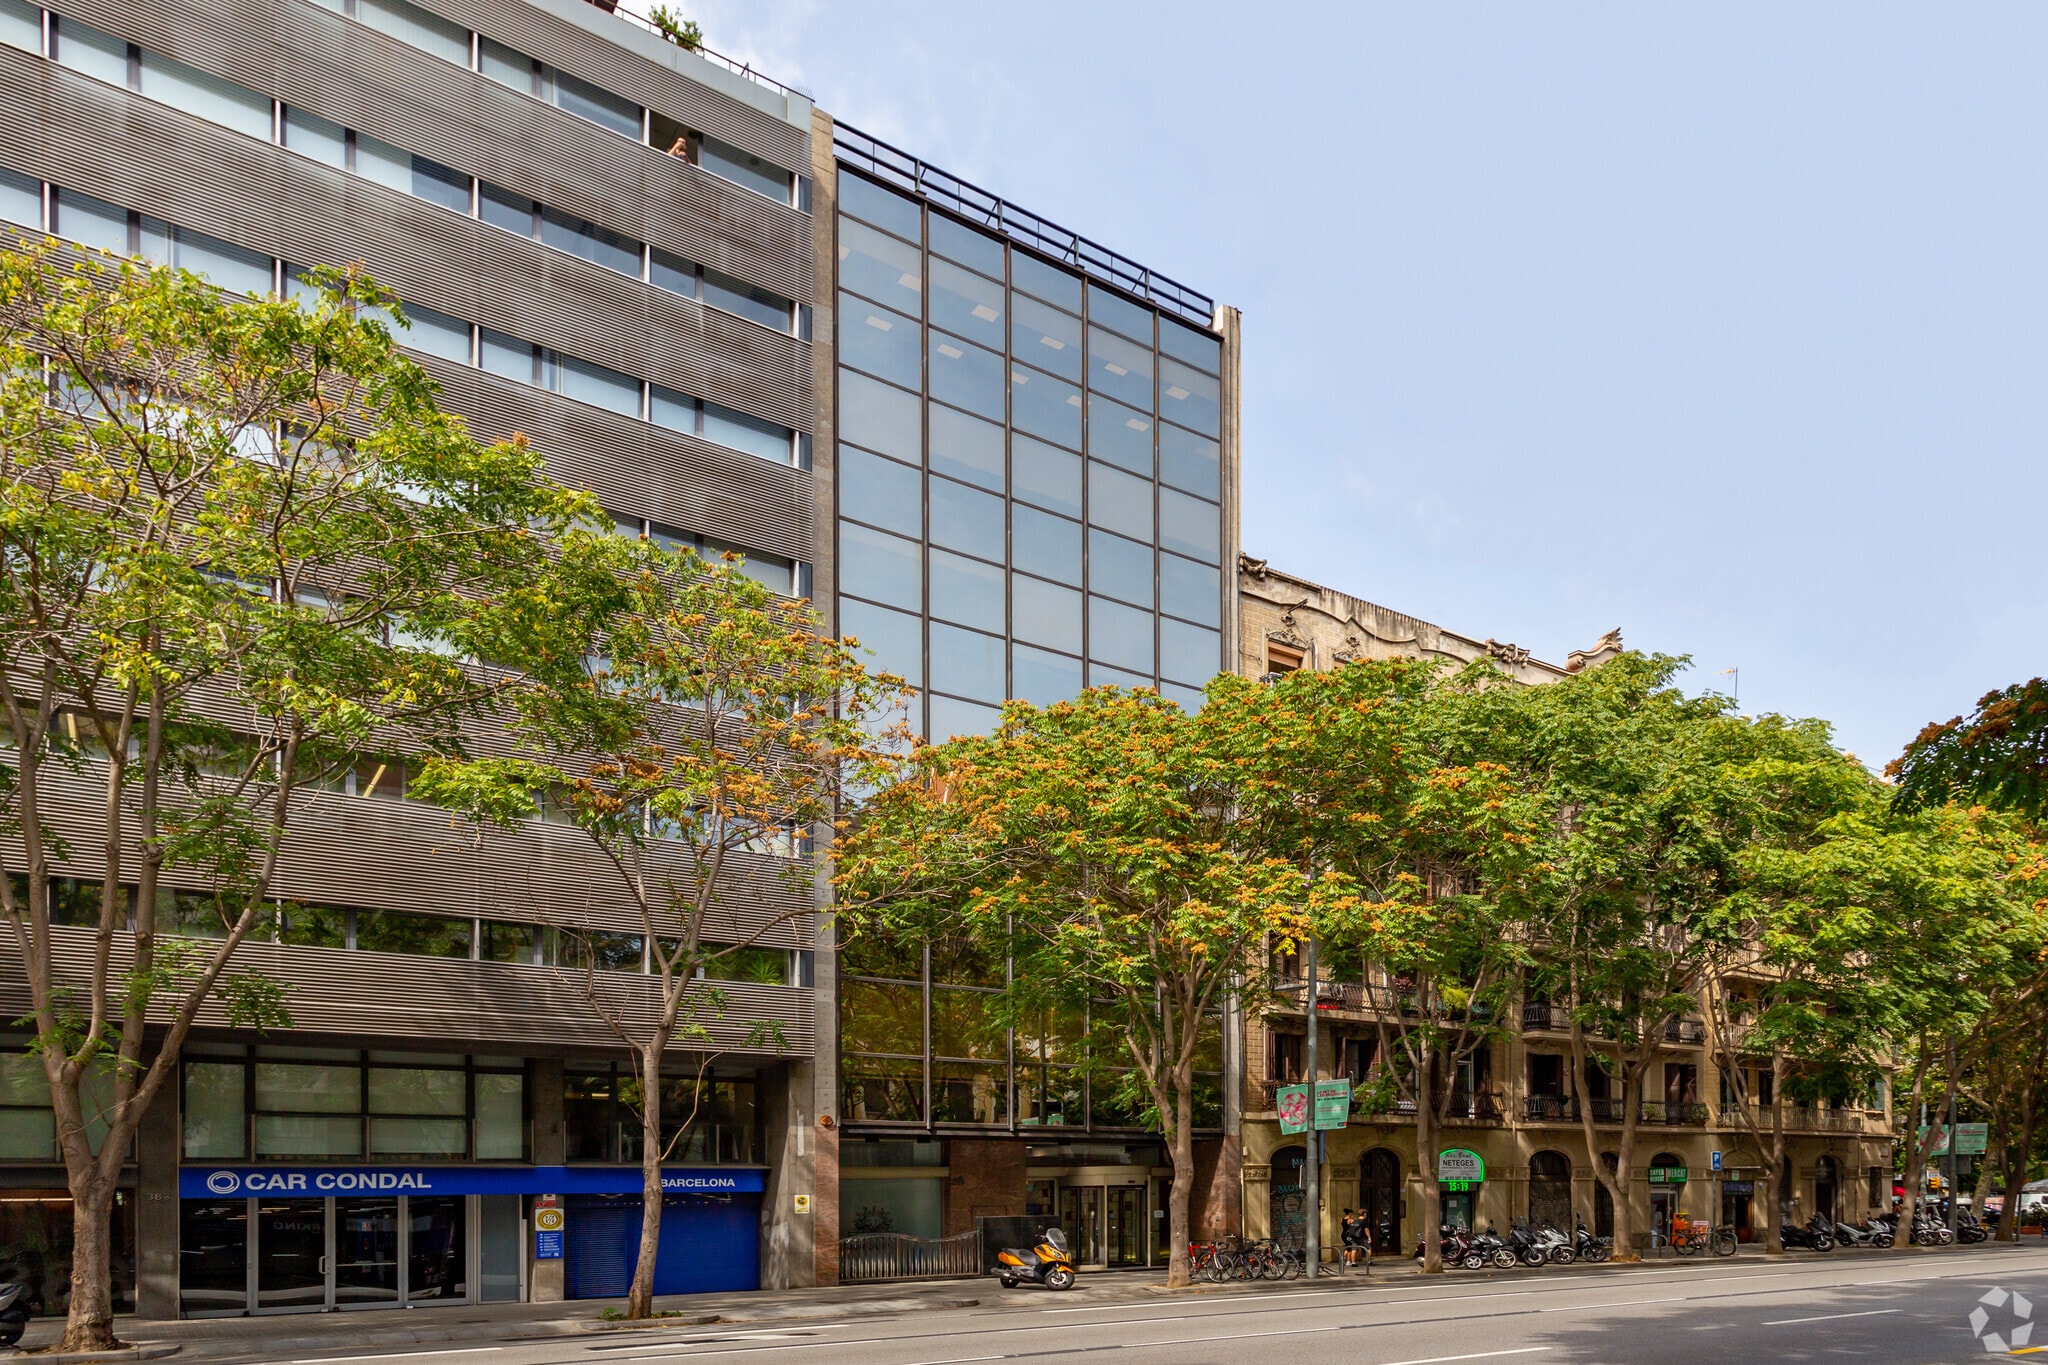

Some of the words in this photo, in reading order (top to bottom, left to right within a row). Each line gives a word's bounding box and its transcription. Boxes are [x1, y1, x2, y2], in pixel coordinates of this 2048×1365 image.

[245, 1173, 307, 1190] CAR
[315, 1173, 432, 1190] CONDAL
[661, 1178, 736, 1188] BARCELONA
